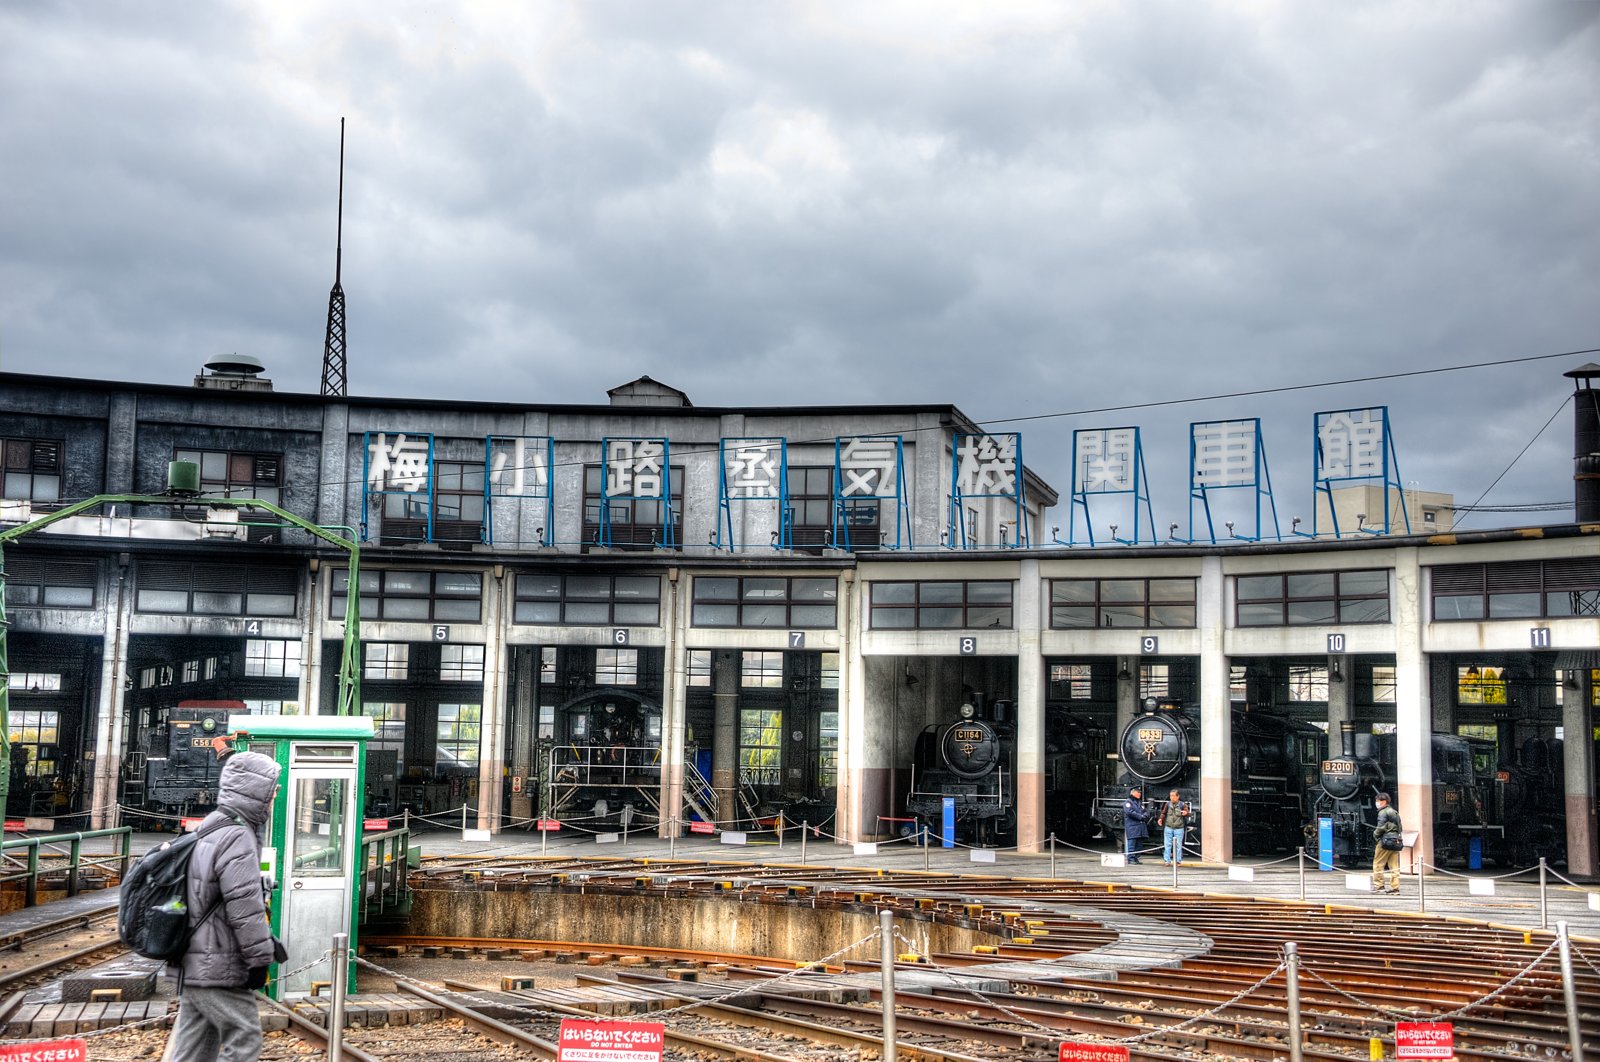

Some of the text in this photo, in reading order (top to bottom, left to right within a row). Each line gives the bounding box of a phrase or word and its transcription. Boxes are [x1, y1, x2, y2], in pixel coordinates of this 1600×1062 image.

[248, 621, 259, 634] 4
[435, 626, 447, 639] 5
[616, 630, 625, 643] 6
[792, 633, 801, 646] 7
[1329, 635, 1342, 650] 10
[1532, 630, 1547, 646] 11
[963, 639, 973, 652] 8
[1144, 638, 1154, 652] 9
[1325, 763, 1351, 771] B2010
[563, 1028, 661, 1043] はいらないでください
